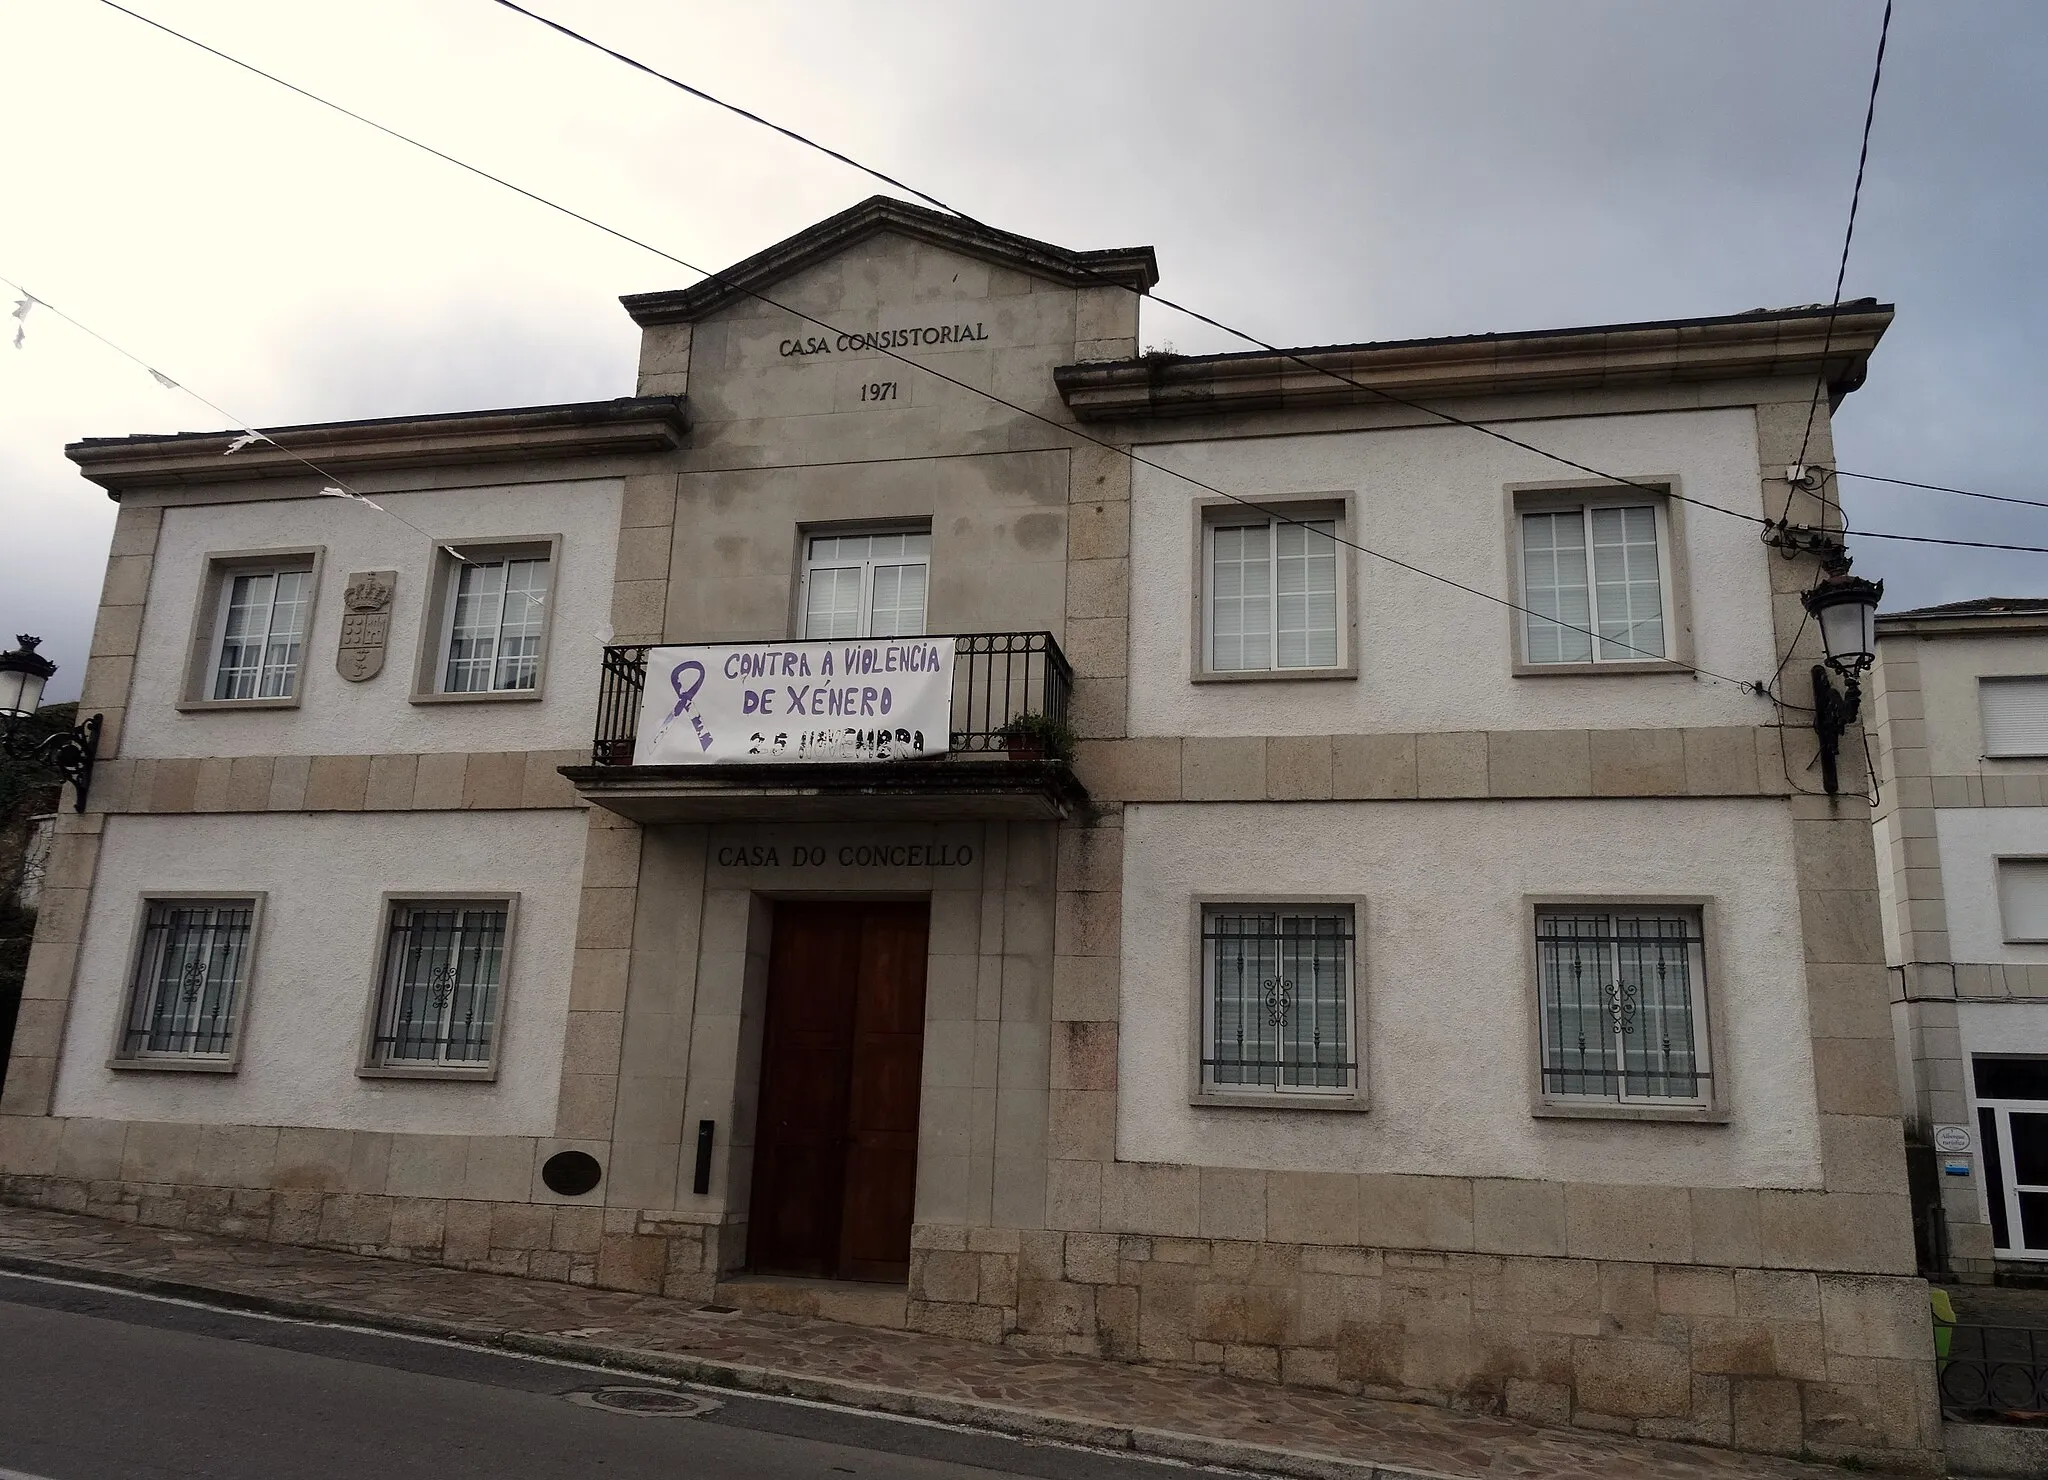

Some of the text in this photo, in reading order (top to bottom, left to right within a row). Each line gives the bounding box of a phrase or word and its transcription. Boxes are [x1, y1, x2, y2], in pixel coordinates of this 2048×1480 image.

[779, 323, 989, 357] CASA CONSISTORIAL
[860, 382, 897, 401] 1971
[724, 652, 811, 680] CONTRA
[821, 650, 834, 676] A
[742, 680, 891, 716] DE XÉNERO
[718, 845, 973, 867] CASA DO CONCELLO
